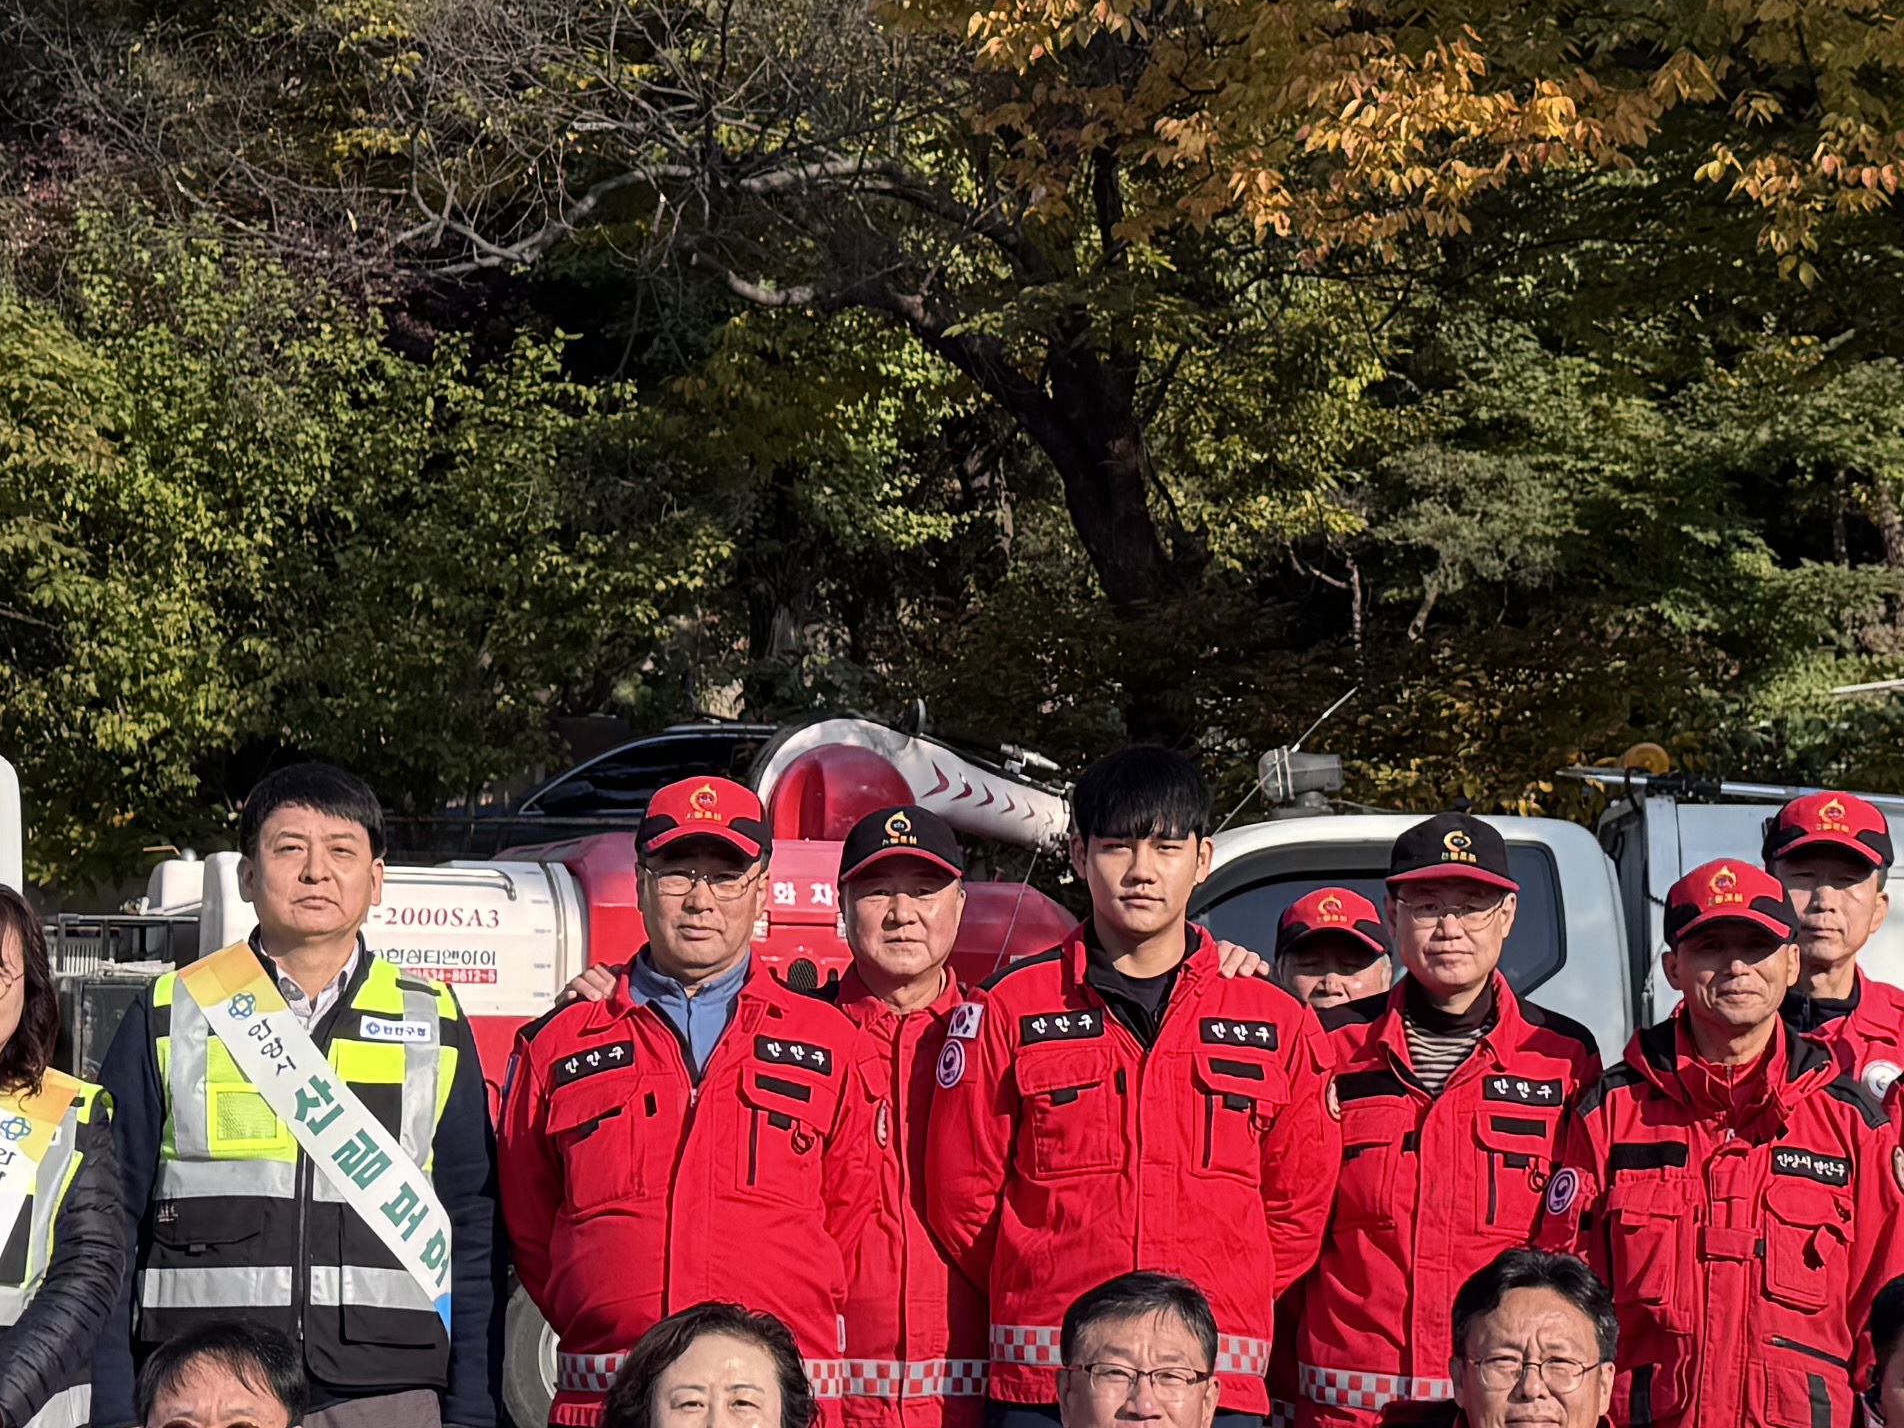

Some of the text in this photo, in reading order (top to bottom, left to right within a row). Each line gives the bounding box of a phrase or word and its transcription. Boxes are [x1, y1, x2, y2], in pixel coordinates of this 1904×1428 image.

[365, 906, 500, 930] -2000SA3
[1031, 1013, 1094, 1035] 만안구
[1210, 1021, 1271, 1044] 만안구
[247, 1018, 297, 1077] 안양시
[564, 1045, 625, 1074] 만안구
[766, 1041, 826, 1066] 만안구
[1493, 1077, 1553, 1100] 만안구
[1776, 1152, 1846, 1178] 안양시 만안구
